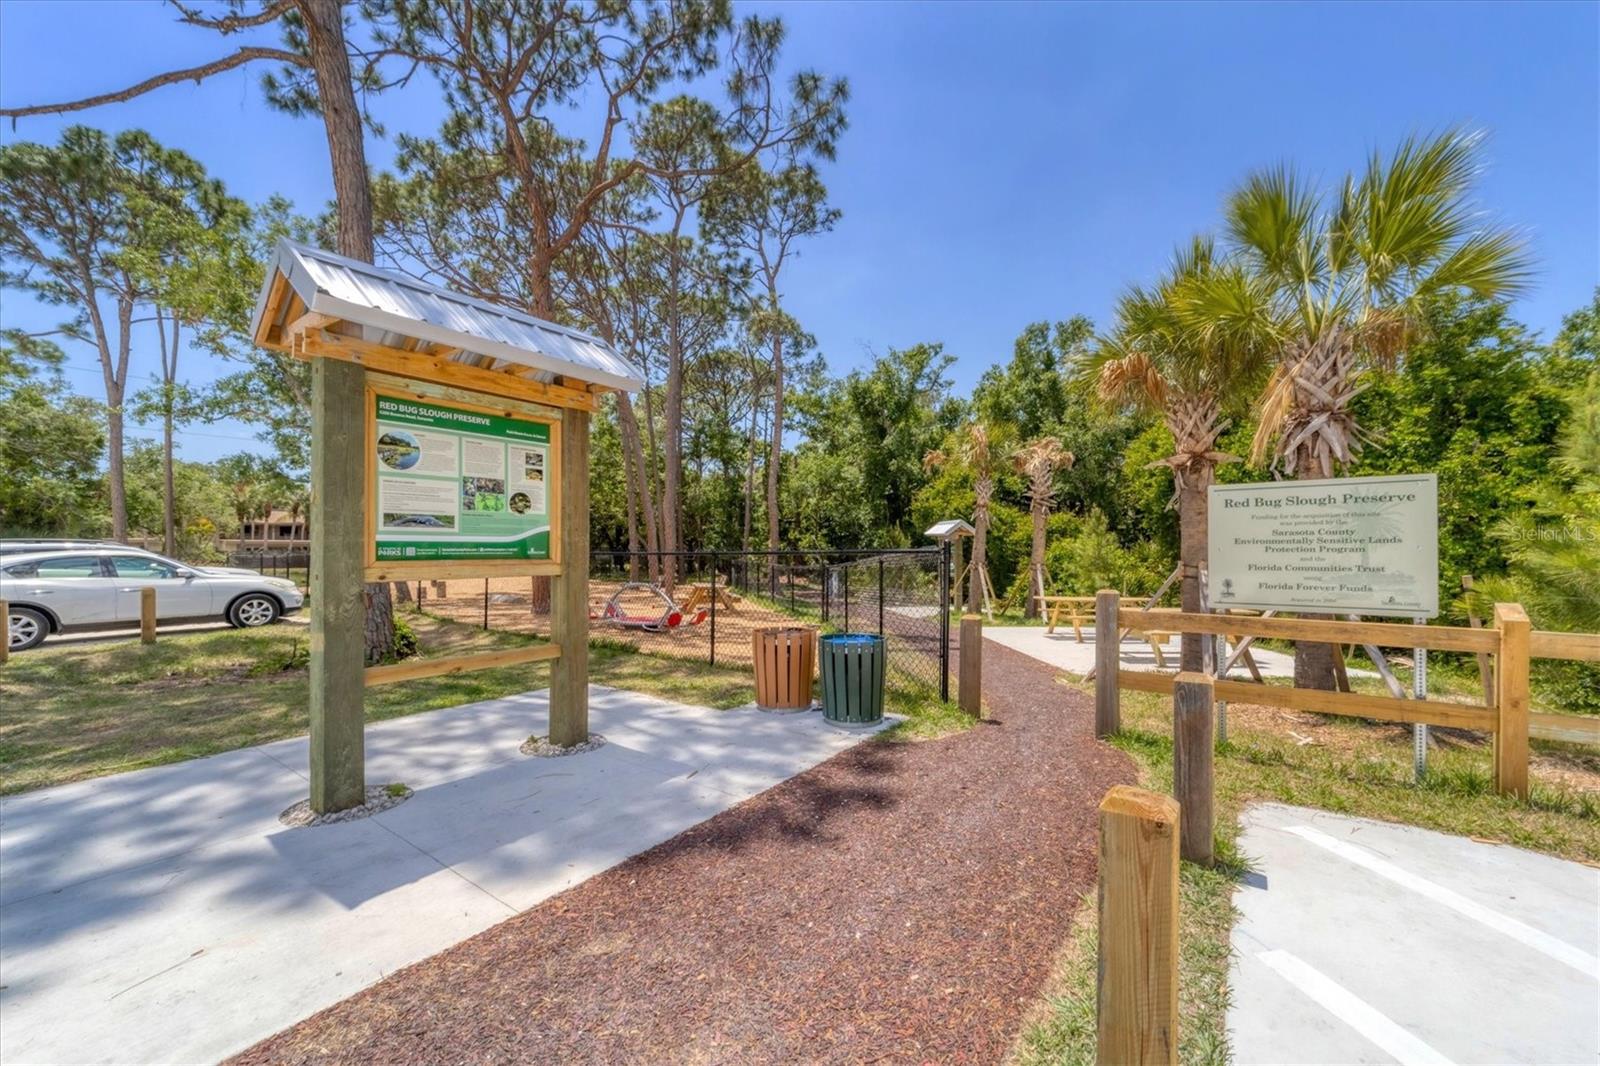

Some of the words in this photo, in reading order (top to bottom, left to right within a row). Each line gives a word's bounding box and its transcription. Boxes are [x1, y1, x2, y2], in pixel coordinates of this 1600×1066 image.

[379, 401, 397, 410] RED
[399, 404, 418, 415] BUG
[419, 407, 453, 420] SLOUGH
[453, 413, 491, 426] PRESERVE
[1224, 498, 1250, 509] Red
[1255, 497, 1282, 508] Bug
[1285, 494, 1337, 507] Slough
[1343, 493, 1416, 504] Preserve
[1318, 528, 1356, 536] County
[1234, 537, 1314, 546] Environmentally
[1368, 536, 1403, 544] Lands
[1265, 545, 1316, 553] Protection
[1319, 545, 1366, 554] Program
[1248, 563, 1282, 571] Florida
[1284, 564, 1353, 572] Communities
[1355, 564, 1385, 572] Trust
[1258, 582, 1294, 590] Florida
[1296, 583, 1337, 591] Forever
[1339, 584, 1373, 592] Funds
